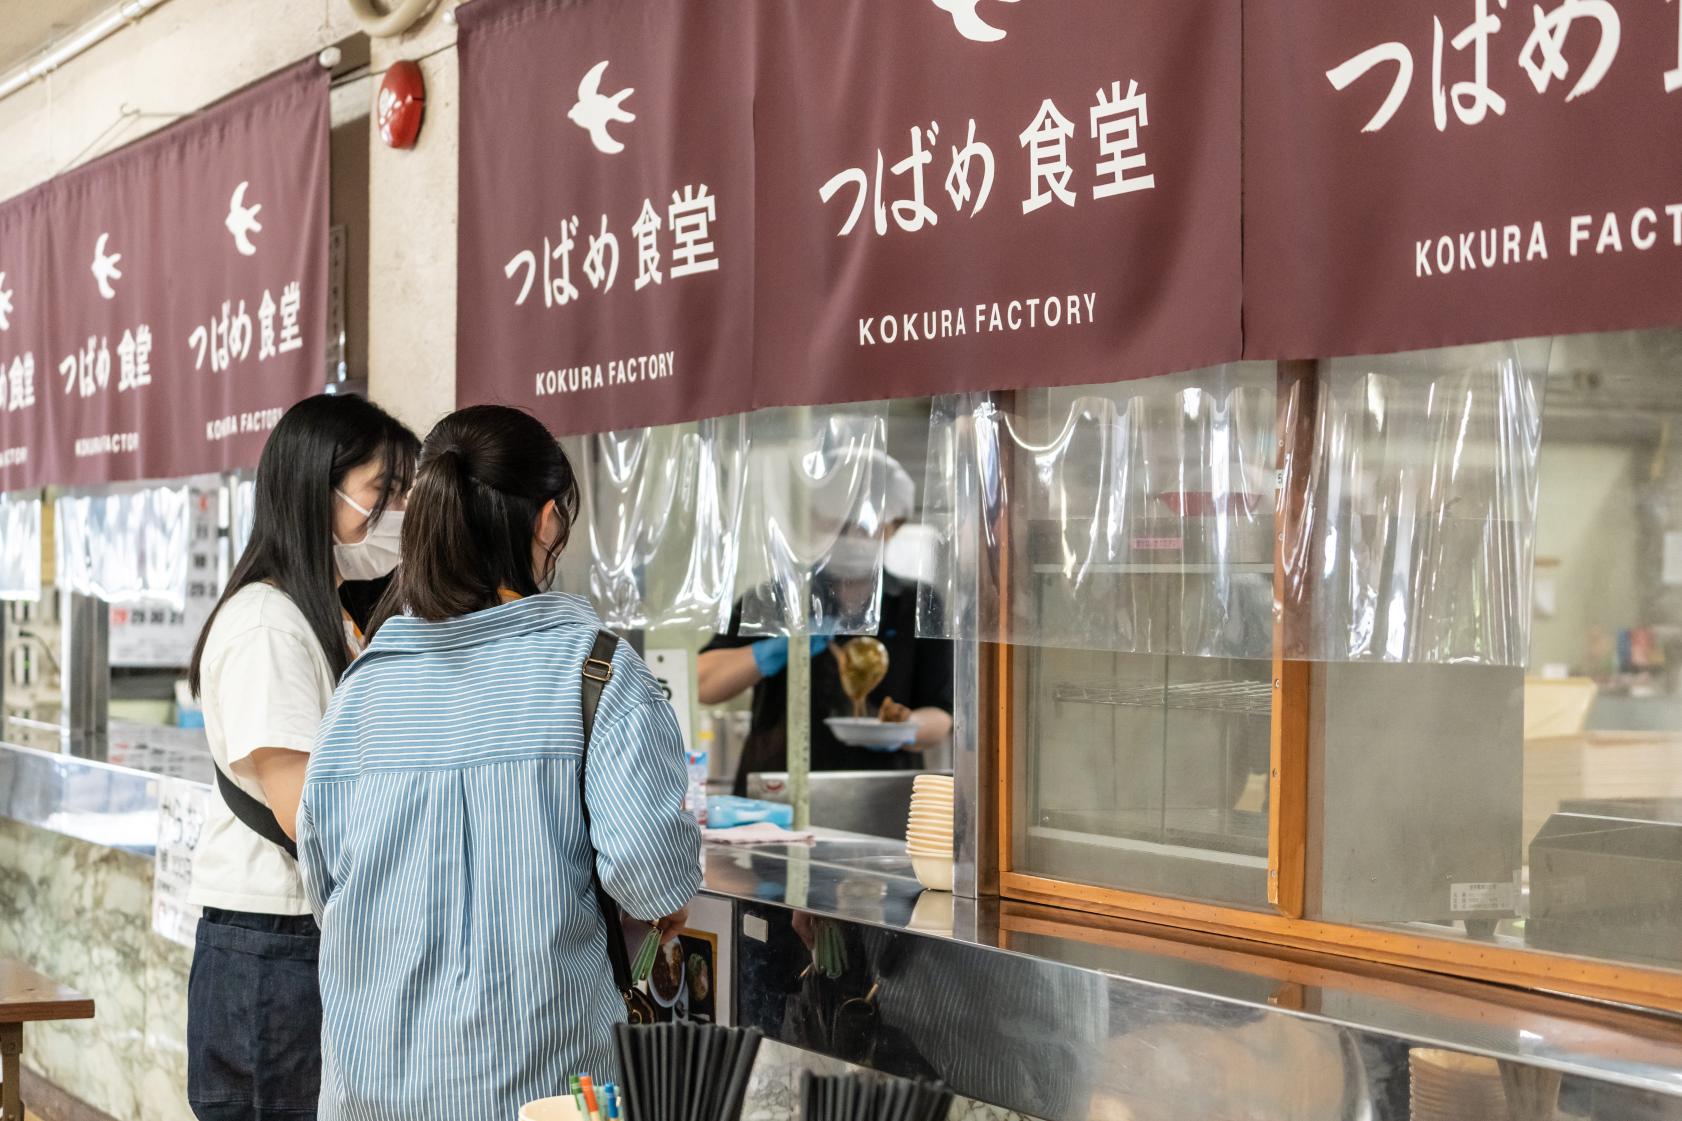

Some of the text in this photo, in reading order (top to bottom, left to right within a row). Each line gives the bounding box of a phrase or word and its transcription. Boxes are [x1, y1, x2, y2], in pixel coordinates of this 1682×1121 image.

[1325, 0, 1682, 132] つばめ
[818, 78, 1155, 236] つばめ食堂
[504, 183, 719, 308] つばめ食堂
[1415, 221, 1548, 277] KOKURA
[59, 323, 152, 398] つばめ食堂
[188, 281, 303, 373] つばめ食堂
[859, 292, 1096, 346] KOKURA FACTORY
[536, 351, 674, 396] KOKURA FACTORY
